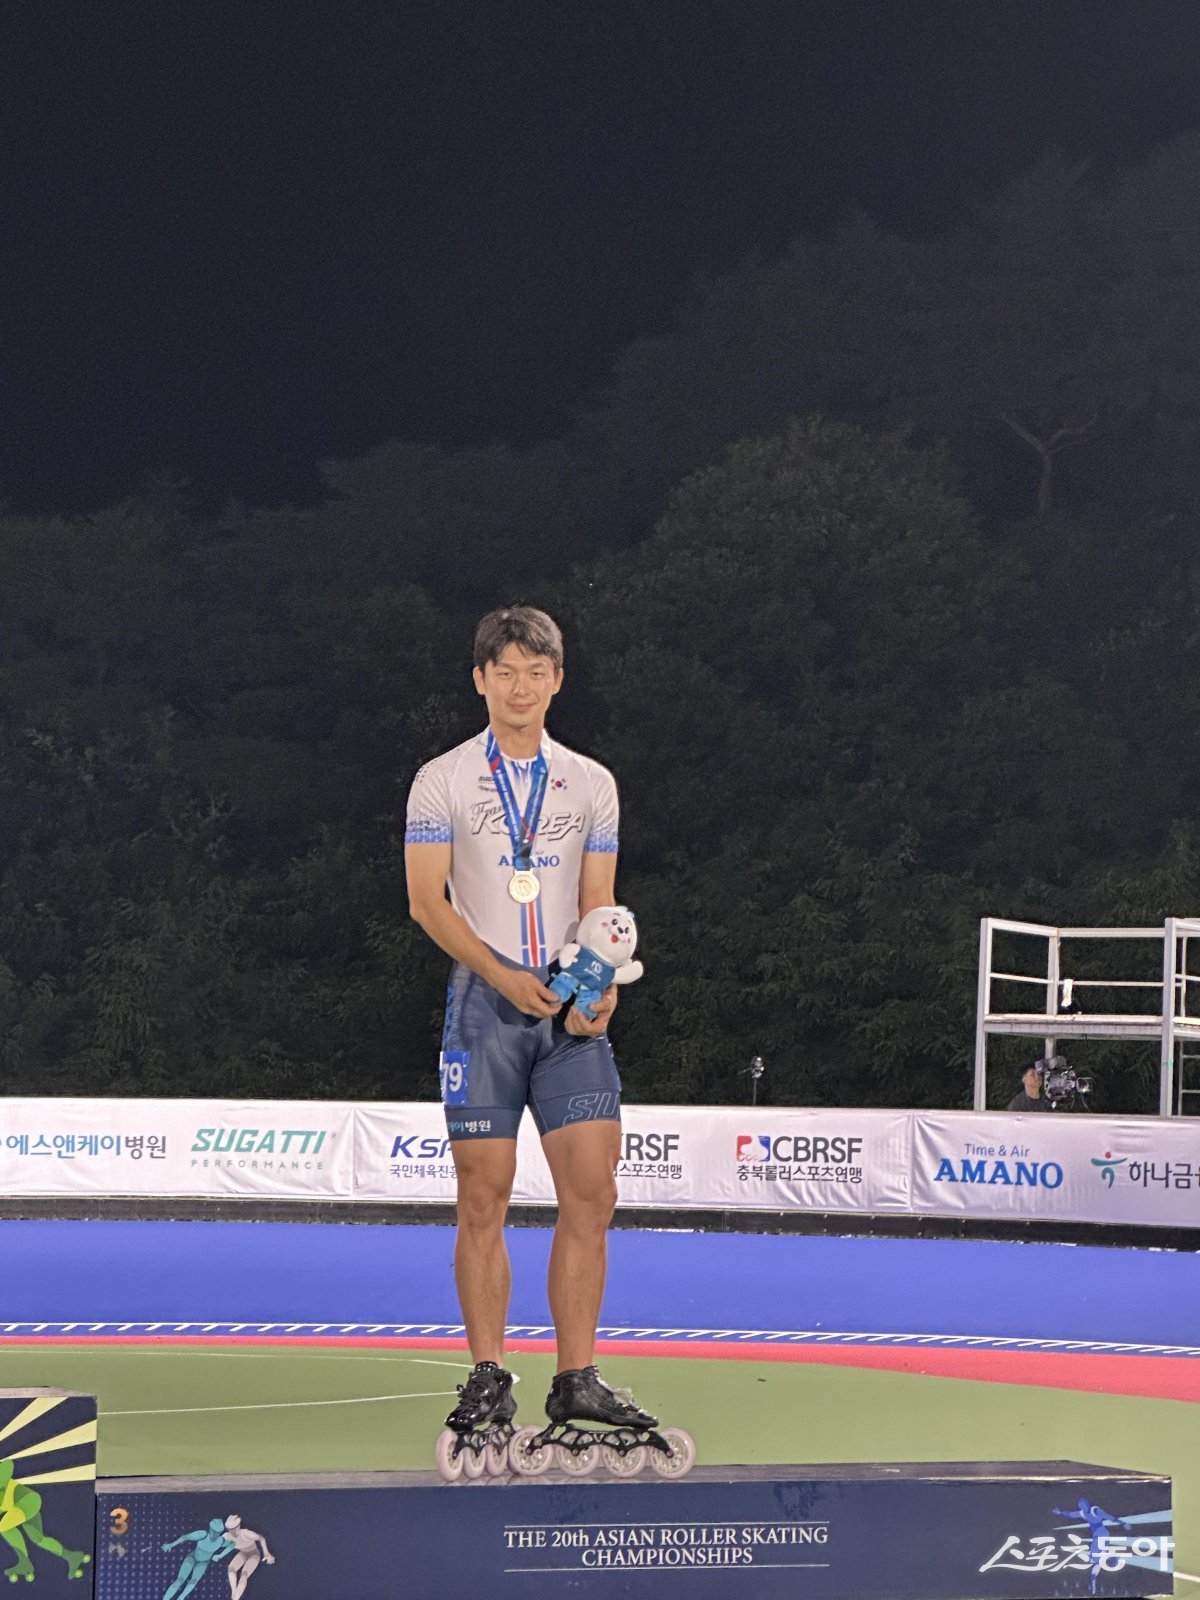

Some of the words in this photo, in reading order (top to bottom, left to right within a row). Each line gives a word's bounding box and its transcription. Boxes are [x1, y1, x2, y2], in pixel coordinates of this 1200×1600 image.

[498, 855, 560, 868] AANO
[190, 1128, 327, 1154] SUGATTI
[620, 1133, 680, 1161] RSF
[772, 1135, 862, 1163] CBRSF
[964, 1143, 995, 1157] Time
[998, 1145, 1006, 1157] &
[1010, 1146, 1030, 1158] Air
[191, 1160, 325, 1170] PERFORMANCE
[615, 1163, 682, 1179] 스포츠연맹
[737, 1165, 862, 1184] 충북롤러스포츠연맹
[934, 1158, 1064, 1189] AMANO
[1129, 1161, 1200, 1189] 하나금
[110, 1508, 128, 1535] 3
[504, 1531, 547, 1548] THE
[551, 1529, 590, 1548] 20th
[594, 1528, 655, 1547] ASIAN
[660, 1527, 738, 1546] ROLLER
[741, 1526, 829, 1545] SKATING
[581, 1547, 753, 1567] CHAMPIONSHIPS
